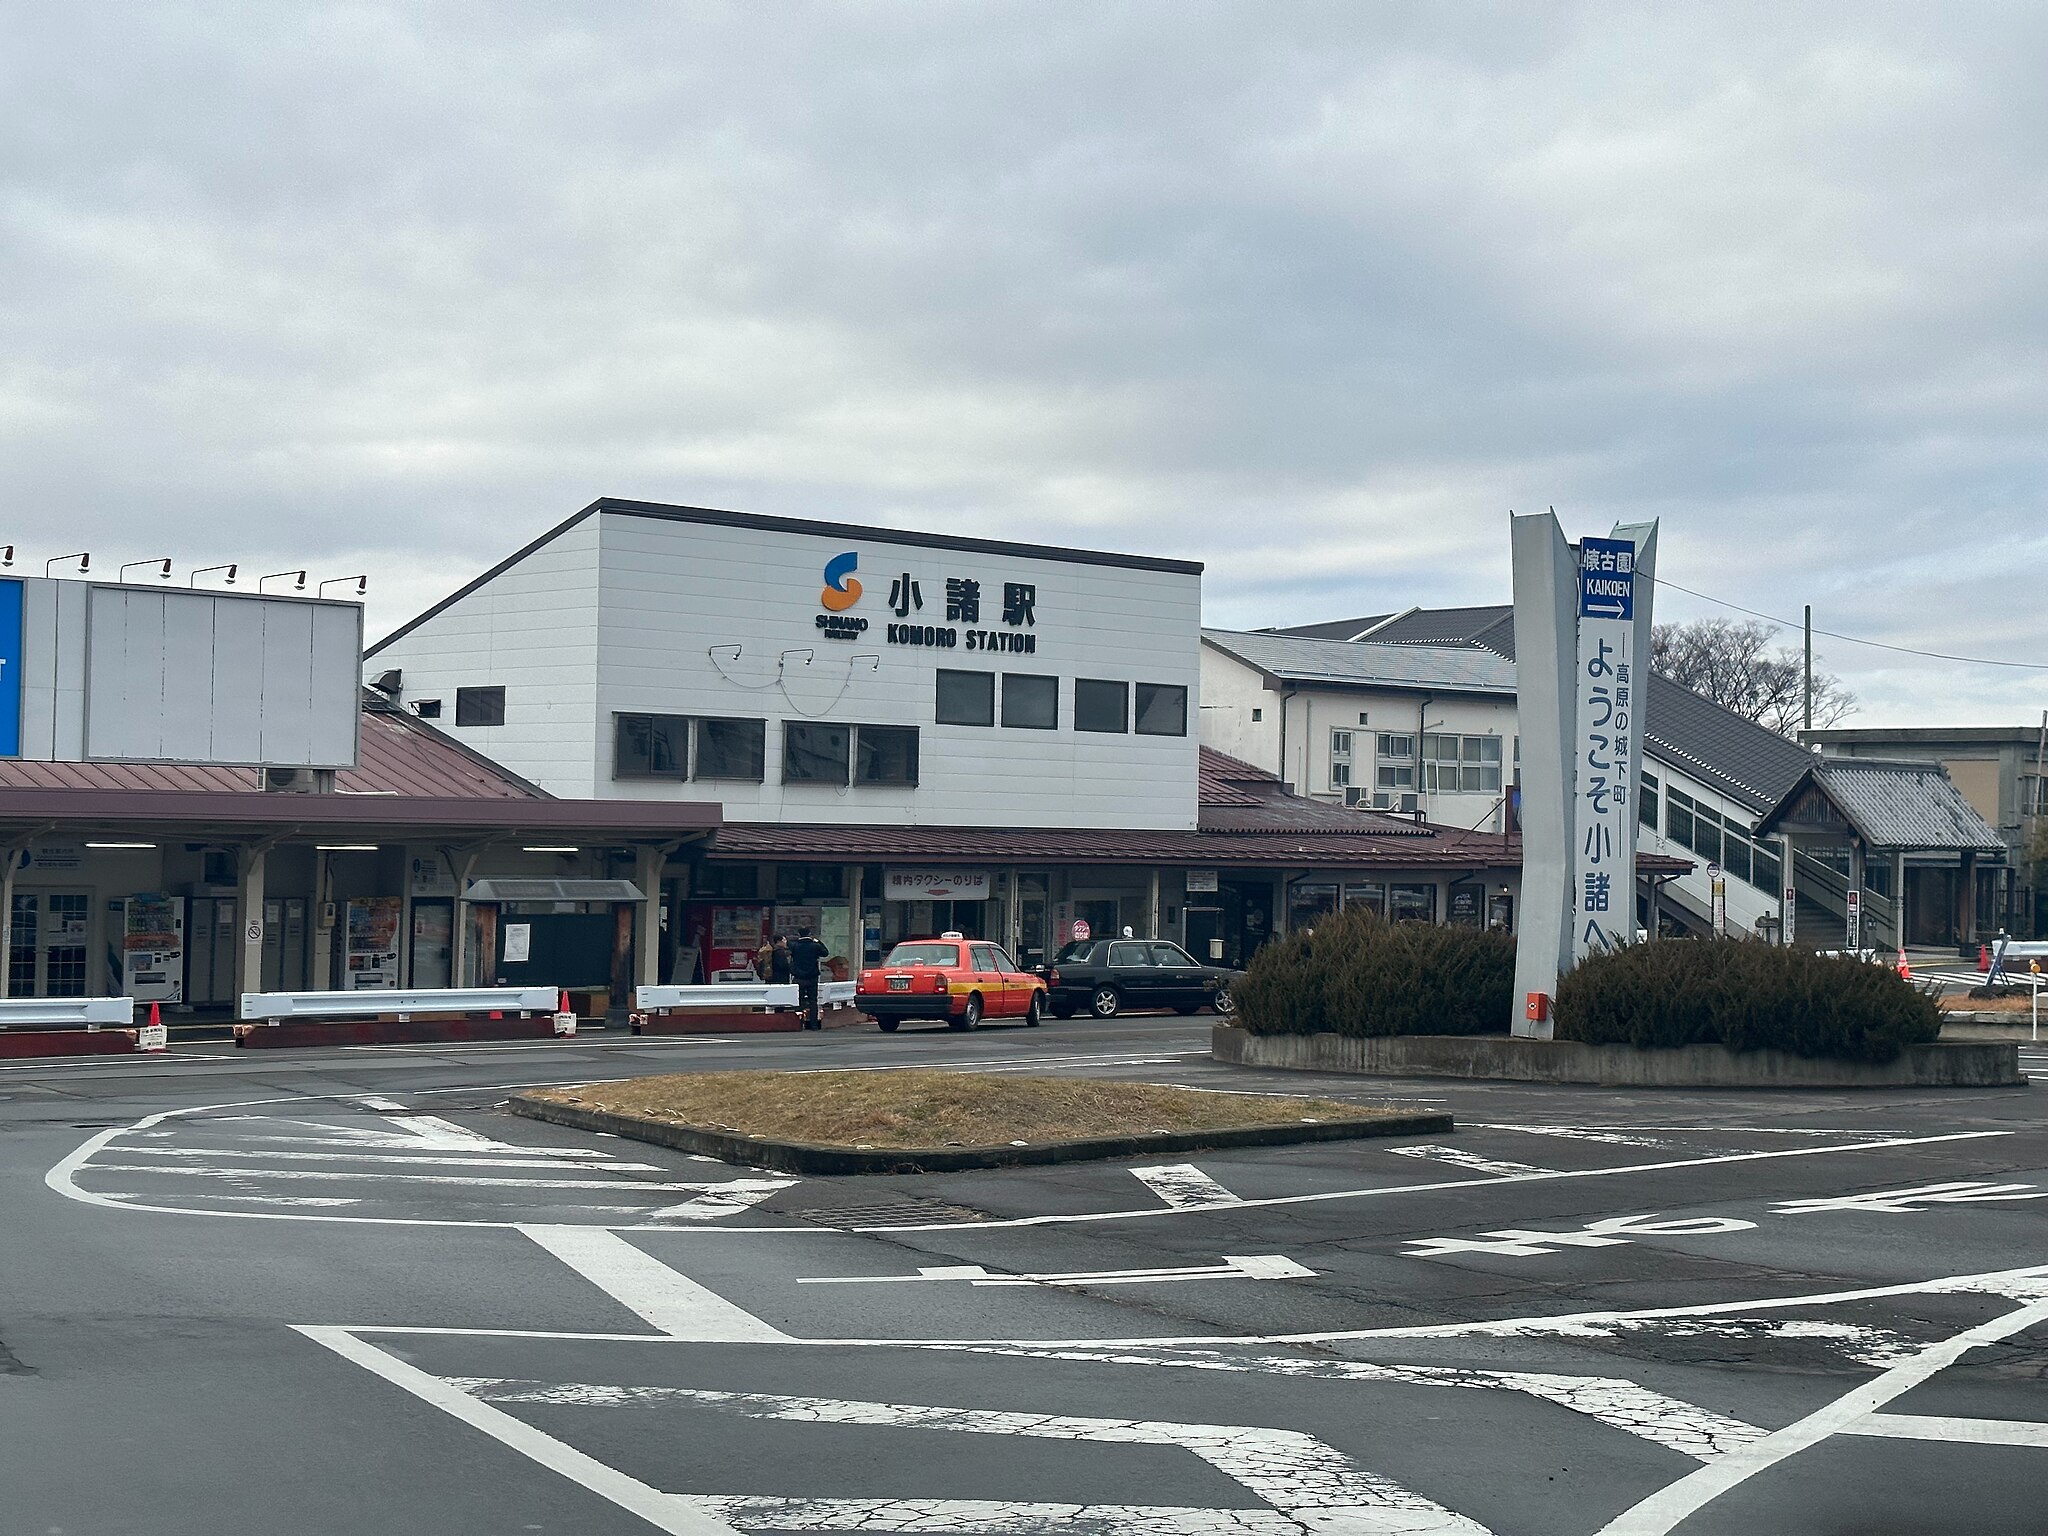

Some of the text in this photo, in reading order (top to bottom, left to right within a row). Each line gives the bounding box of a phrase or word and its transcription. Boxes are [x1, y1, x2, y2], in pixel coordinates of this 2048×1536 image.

[888, 572, 1036, 627] 小諸駅
[1586, 578, 1630, 597] KAIKOEN
[815, 614, 869, 631] SHINANO
[887, 623, 1036, 653] KOMORO STATION
[1584, 637, 1613, 949] ようこそ小諸へ
